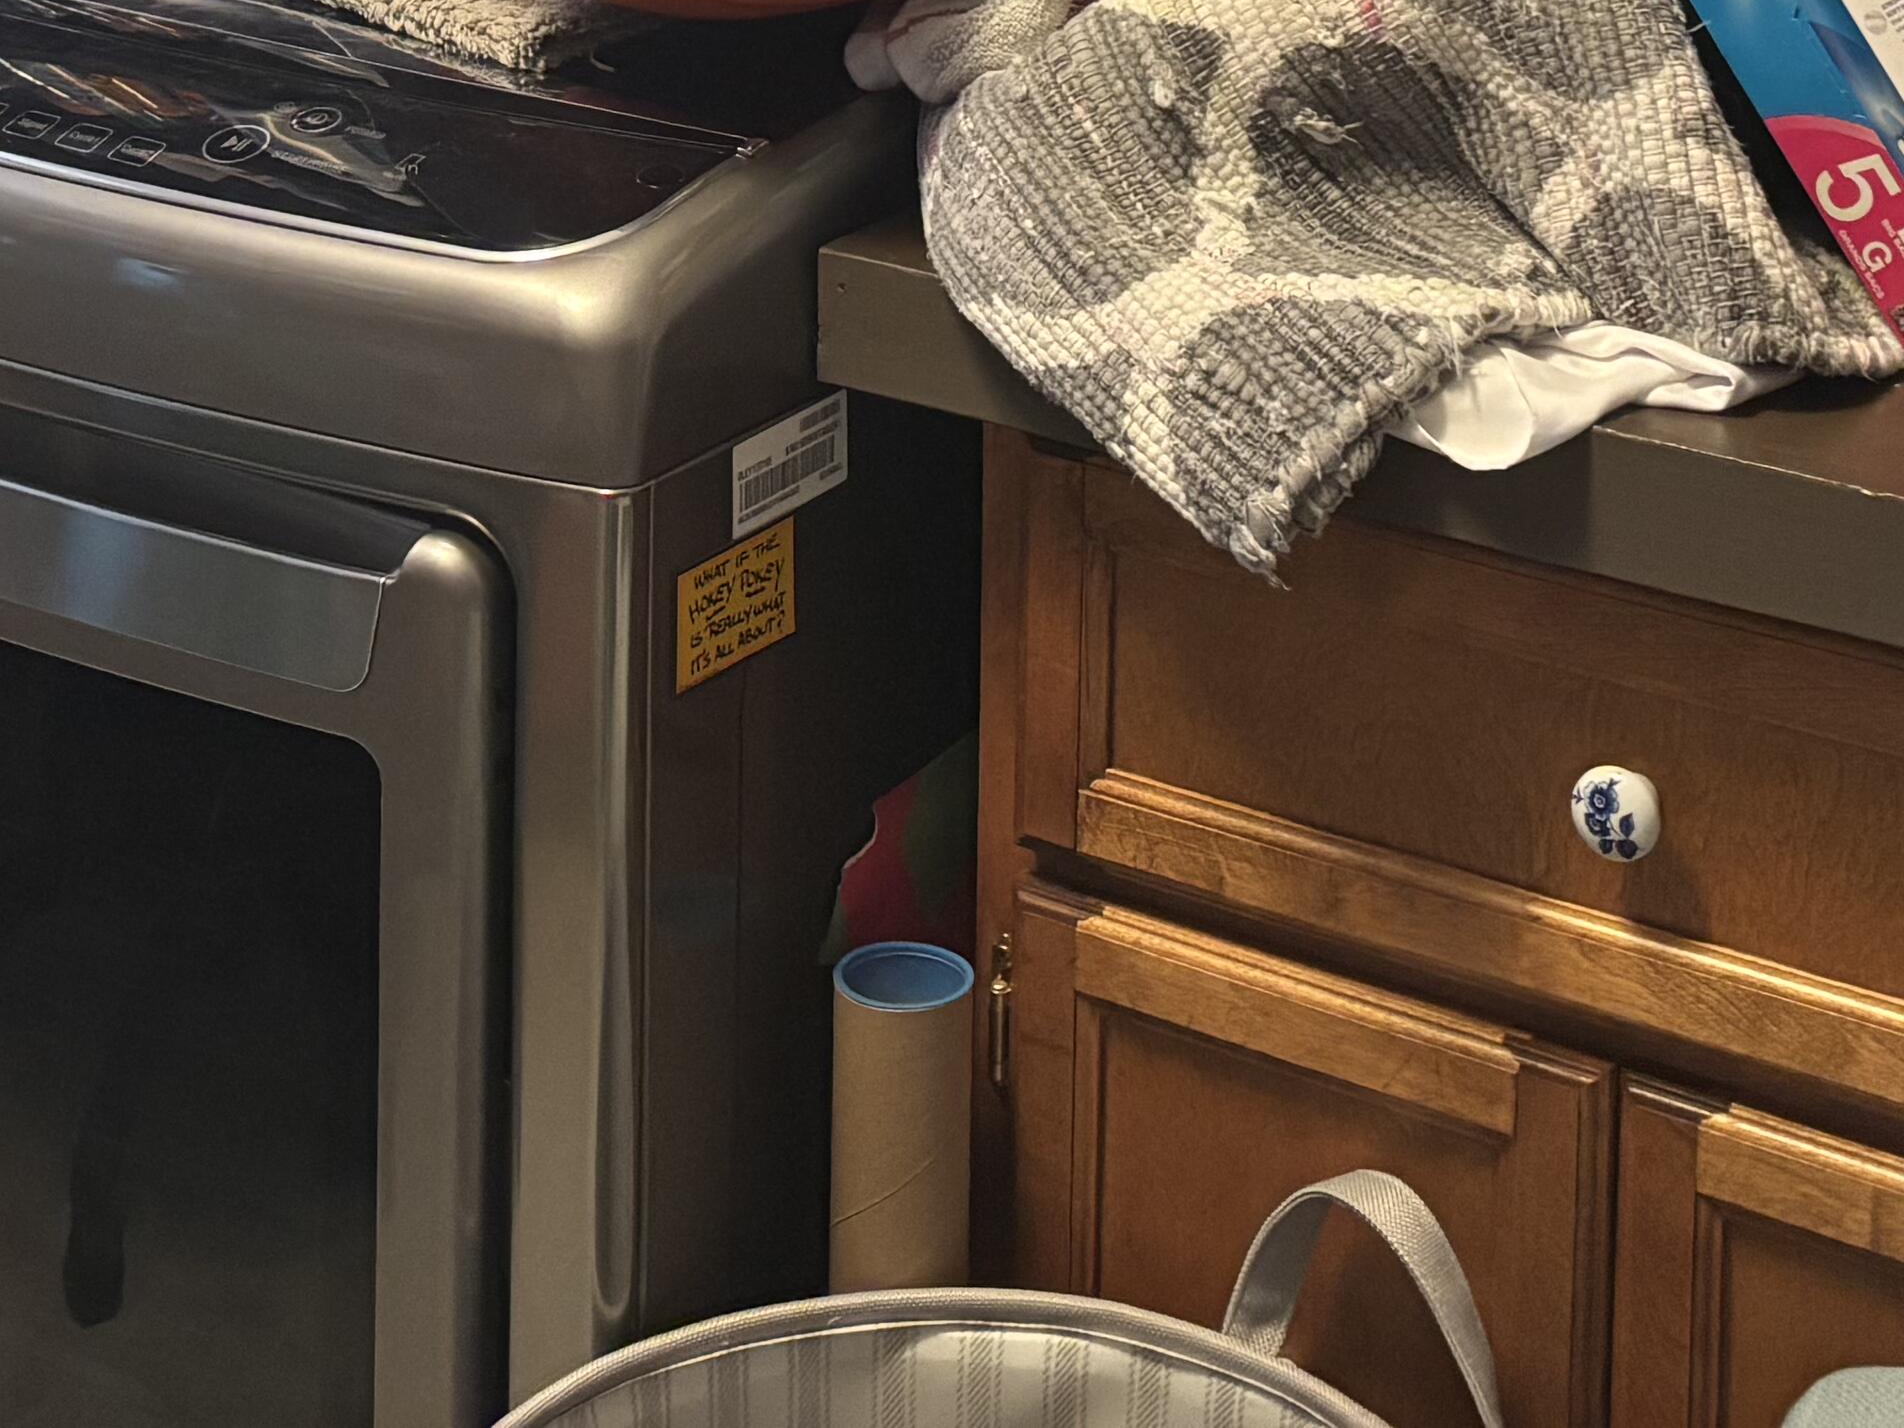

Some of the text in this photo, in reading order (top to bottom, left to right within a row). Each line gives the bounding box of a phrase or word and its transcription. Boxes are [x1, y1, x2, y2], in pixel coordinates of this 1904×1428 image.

[1815, 153, 1902, 222] 5
[1861, 240, 1893, 273] G
[1881, 218, 1898, 239] BIG
[1838, 229, 1885, 300] GRANDS SACS
[689, 556, 785, 625] HOKEY POKEY
[694, 531, 781, 590] WHAT IF THE
[690, 590, 786, 649] IS REALLY WHAT
[691, 609, 786, 675] IT'S ALL ABOUT?
